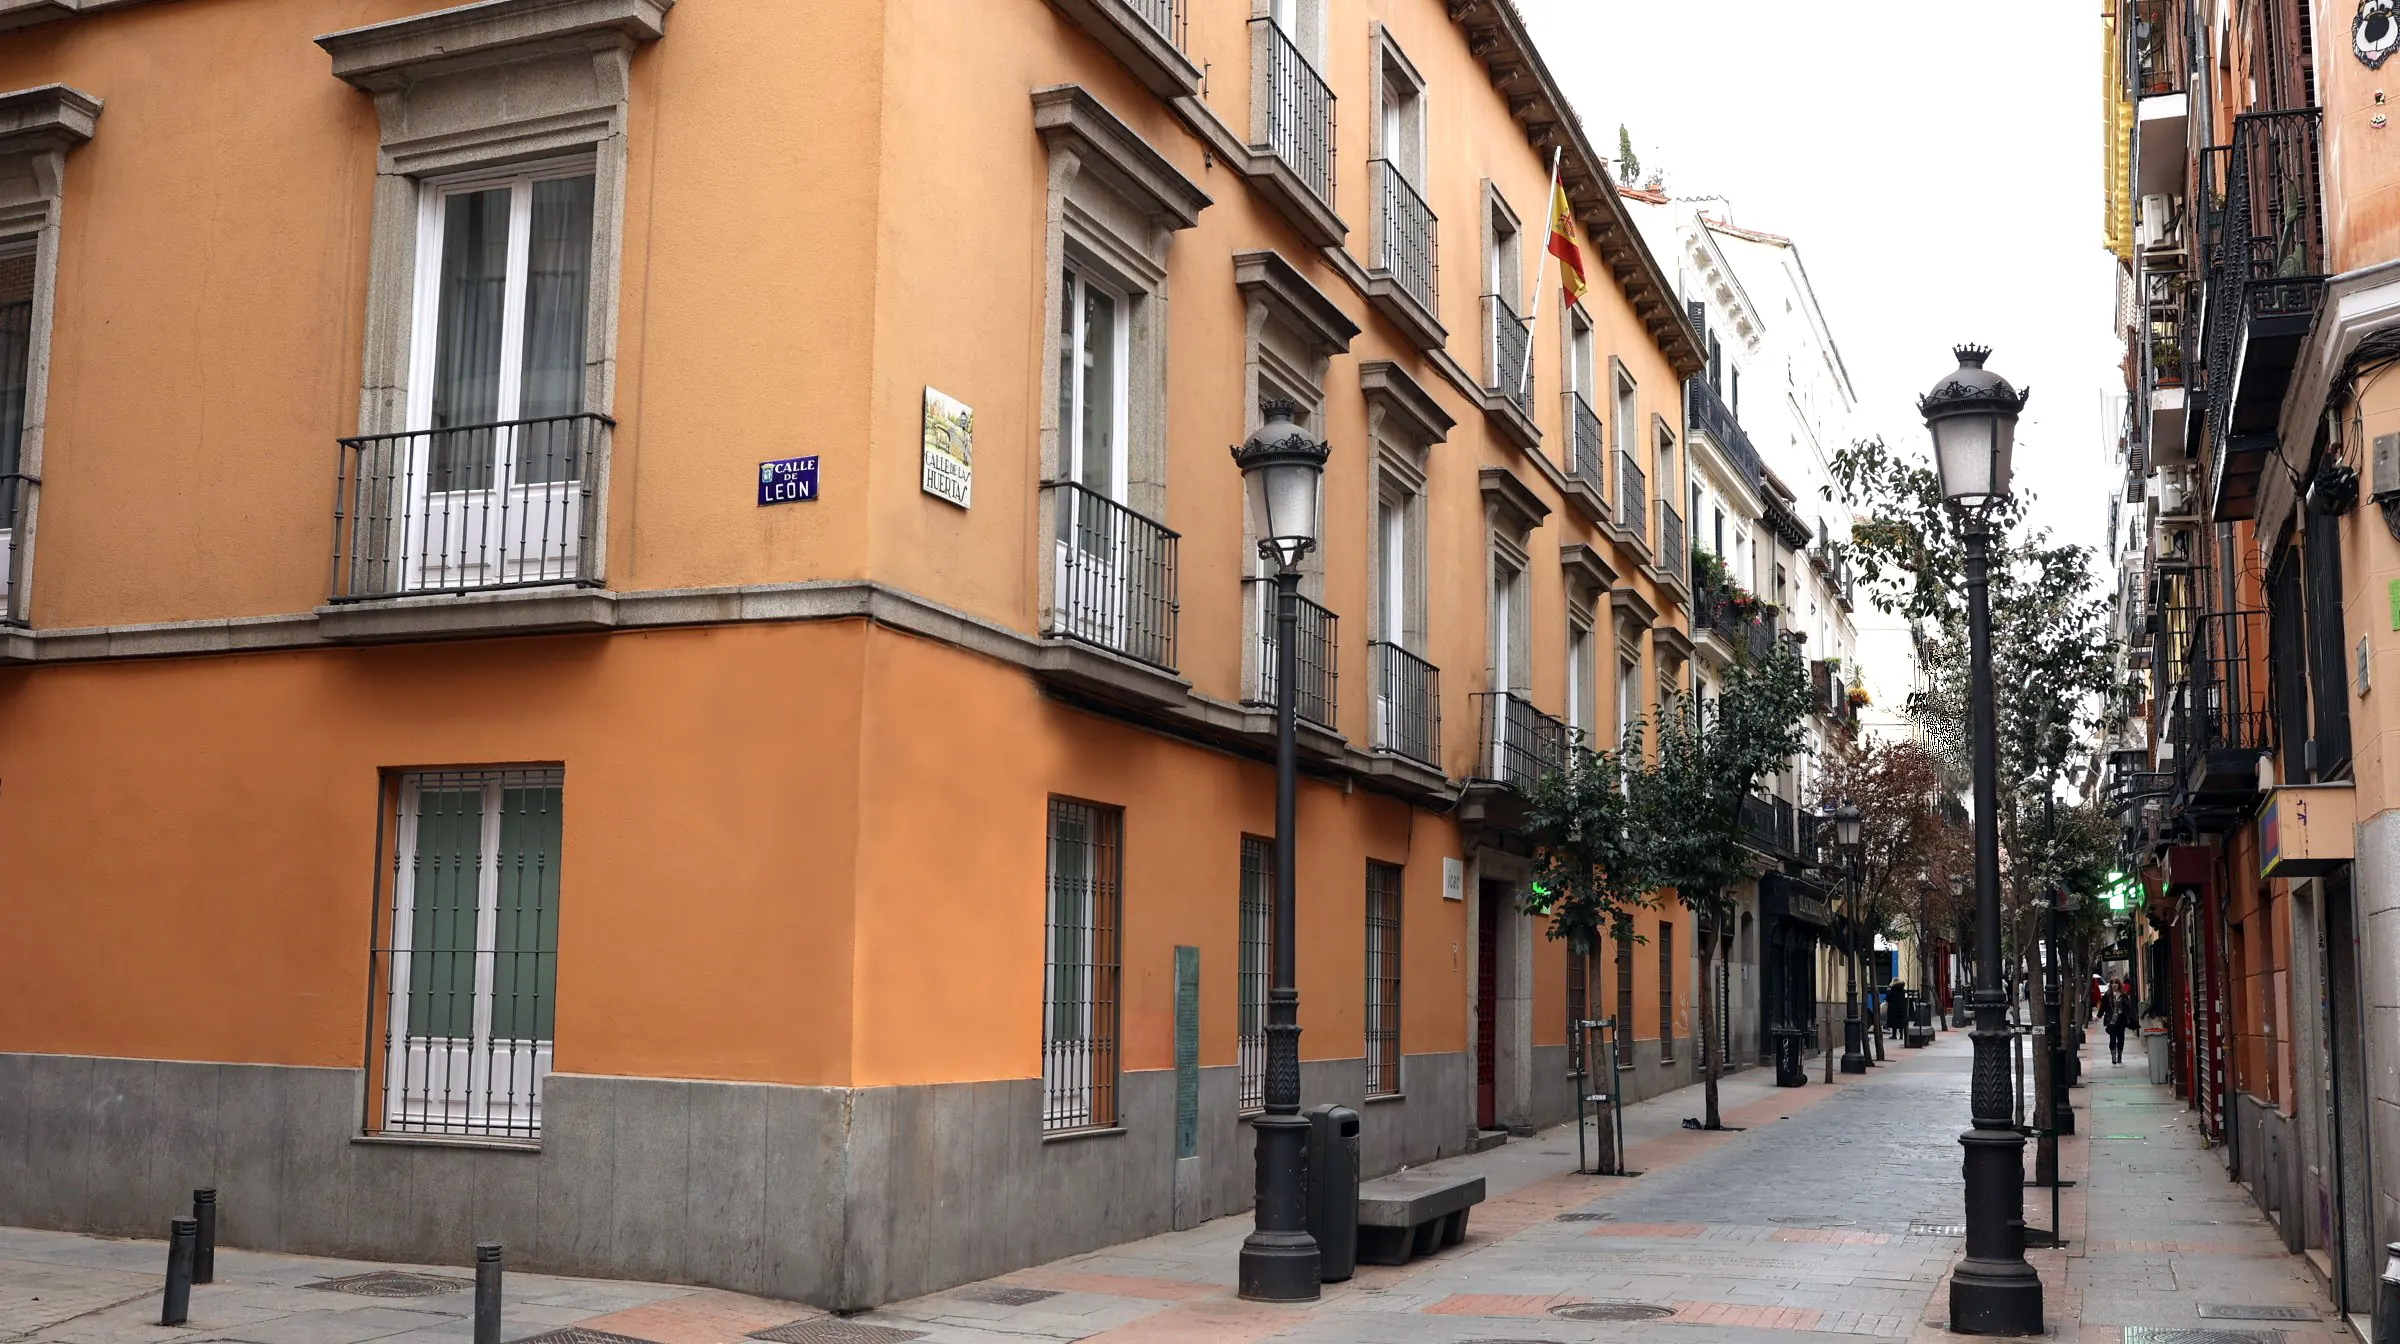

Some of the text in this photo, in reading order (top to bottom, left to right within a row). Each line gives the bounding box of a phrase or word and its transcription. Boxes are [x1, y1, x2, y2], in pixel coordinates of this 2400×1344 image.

[774, 459, 815, 474] CALLE
[783, 472, 798, 481] DE
[926, 450, 971, 482] CALLE DE LAS
[926, 468, 968, 503] HUERTAS
